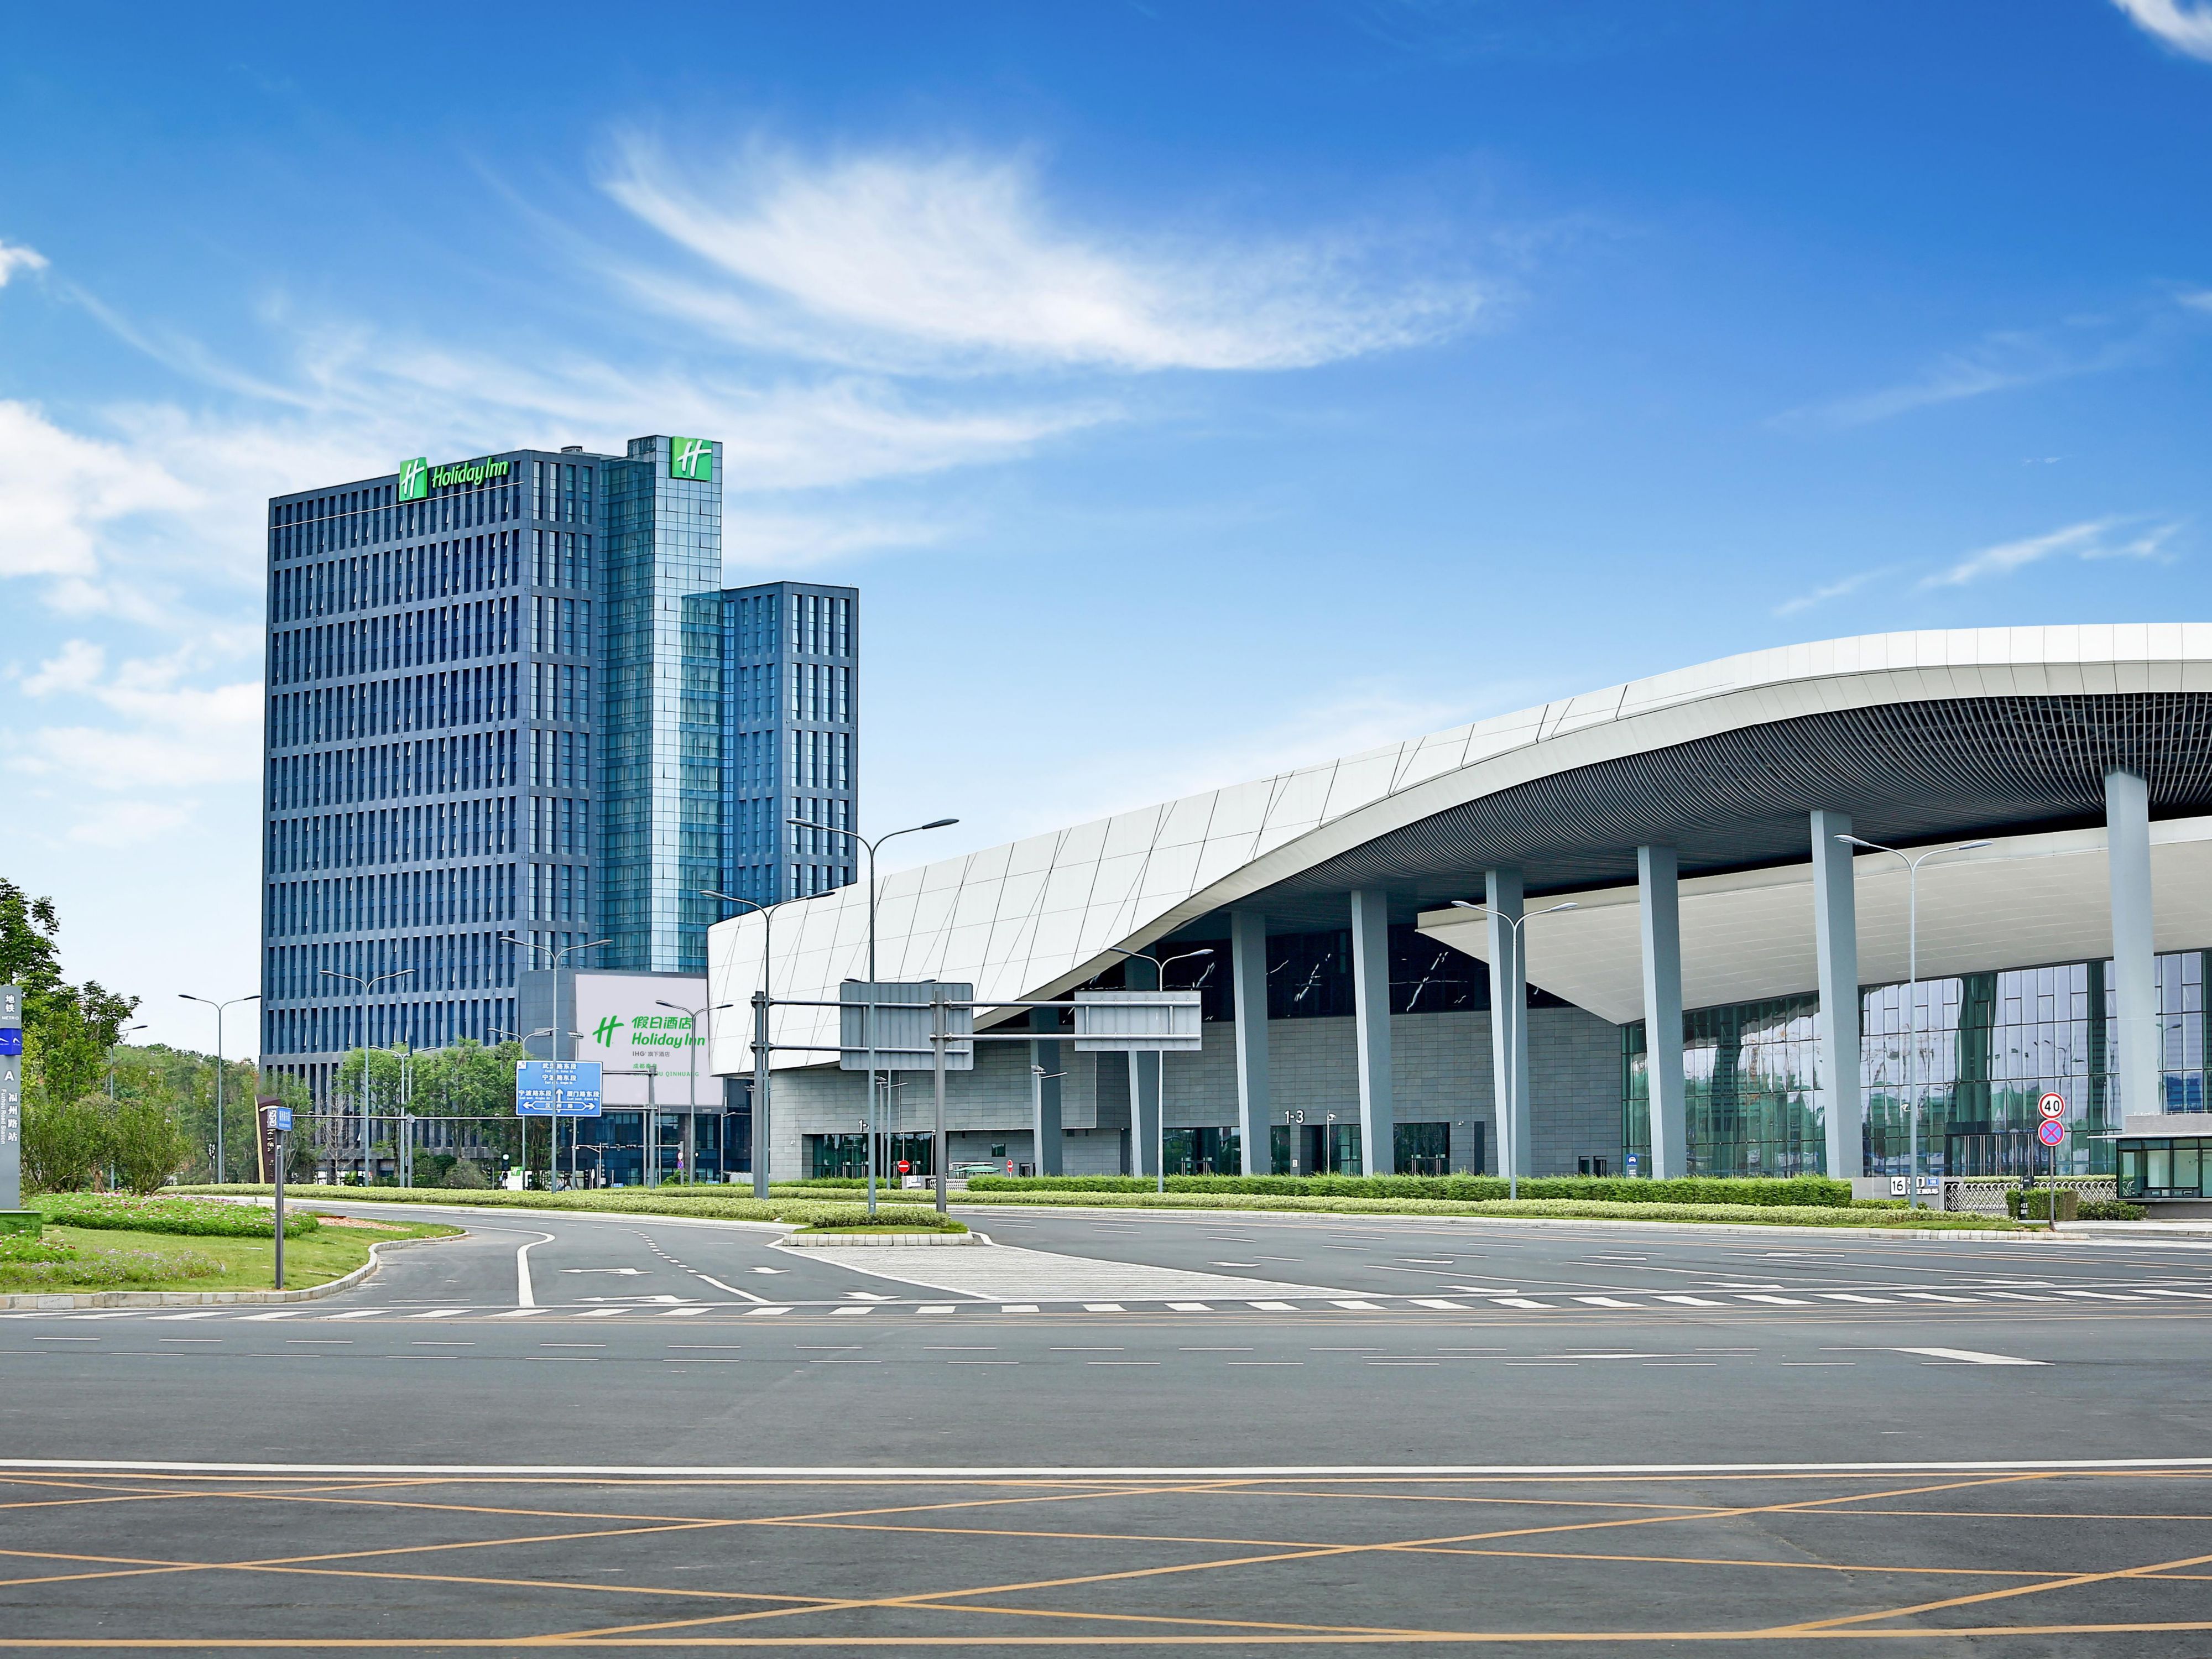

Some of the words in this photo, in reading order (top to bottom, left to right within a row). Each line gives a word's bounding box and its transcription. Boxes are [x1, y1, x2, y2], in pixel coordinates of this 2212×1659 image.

[432, 462, 484, 488] Holiday
[485, 457, 509, 478] Inn
[5, 994, 15, 1013] 地铁
[632, 1016, 692, 1029] 假日酒店
[632, 1032, 683, 1048] Holiday
[685, 1032, 705, 1046] Inn
[4, 1071, 14, 1081] A
[2044, 1100, 2060, 1112] 40
[8, 1093, 18, 1141] 福州路站
[1285, 1110, 1304, 1124] 1-3
[859, 1119, 869, 1132] 1-
[1892, 1181, 1903, 1191] 16
